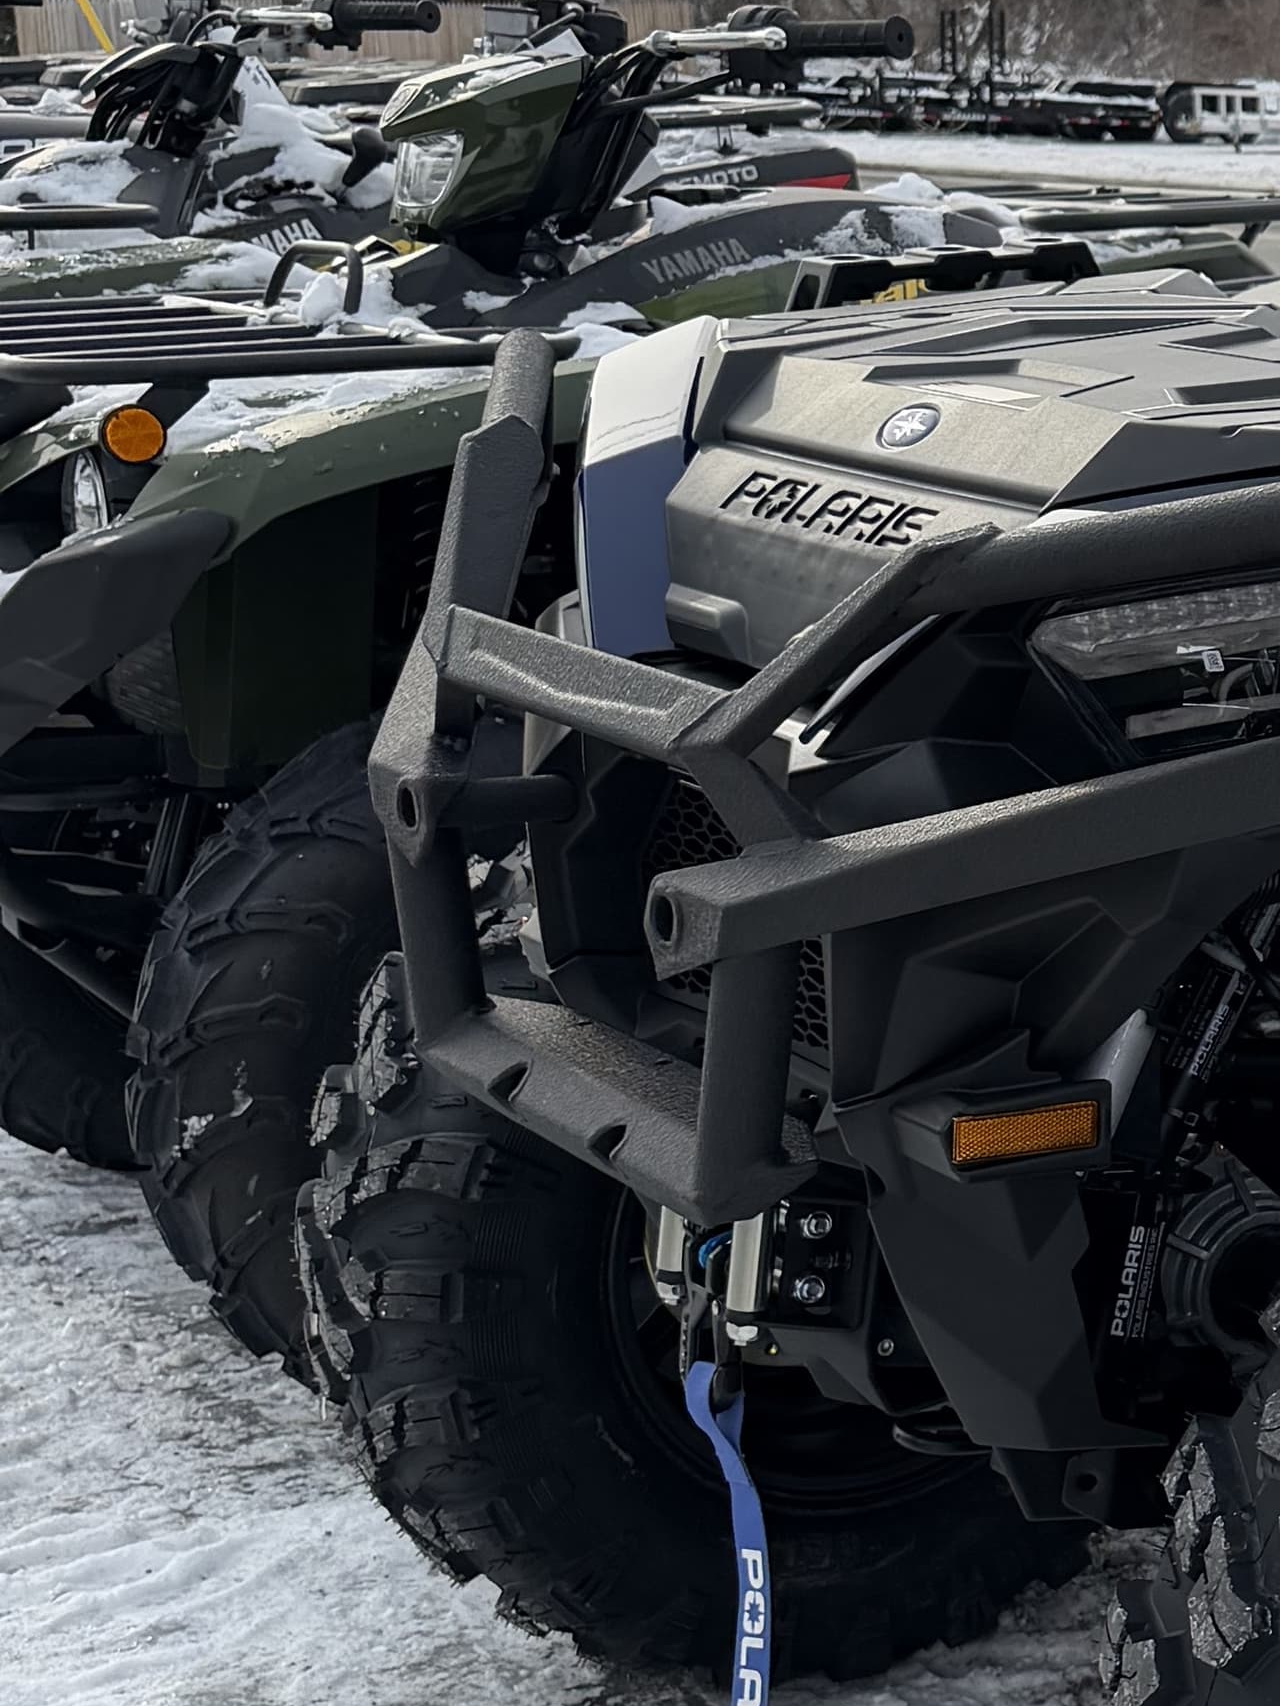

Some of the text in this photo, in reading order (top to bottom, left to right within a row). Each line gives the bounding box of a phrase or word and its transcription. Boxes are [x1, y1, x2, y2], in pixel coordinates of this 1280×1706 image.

[251, 218, 322, 256] MAHA
[641, 238, 751, 284] YAMAHA
[719, 470, 940, 546] POLARIS
[1110, 1225, 1145, 1336] POLARIS
